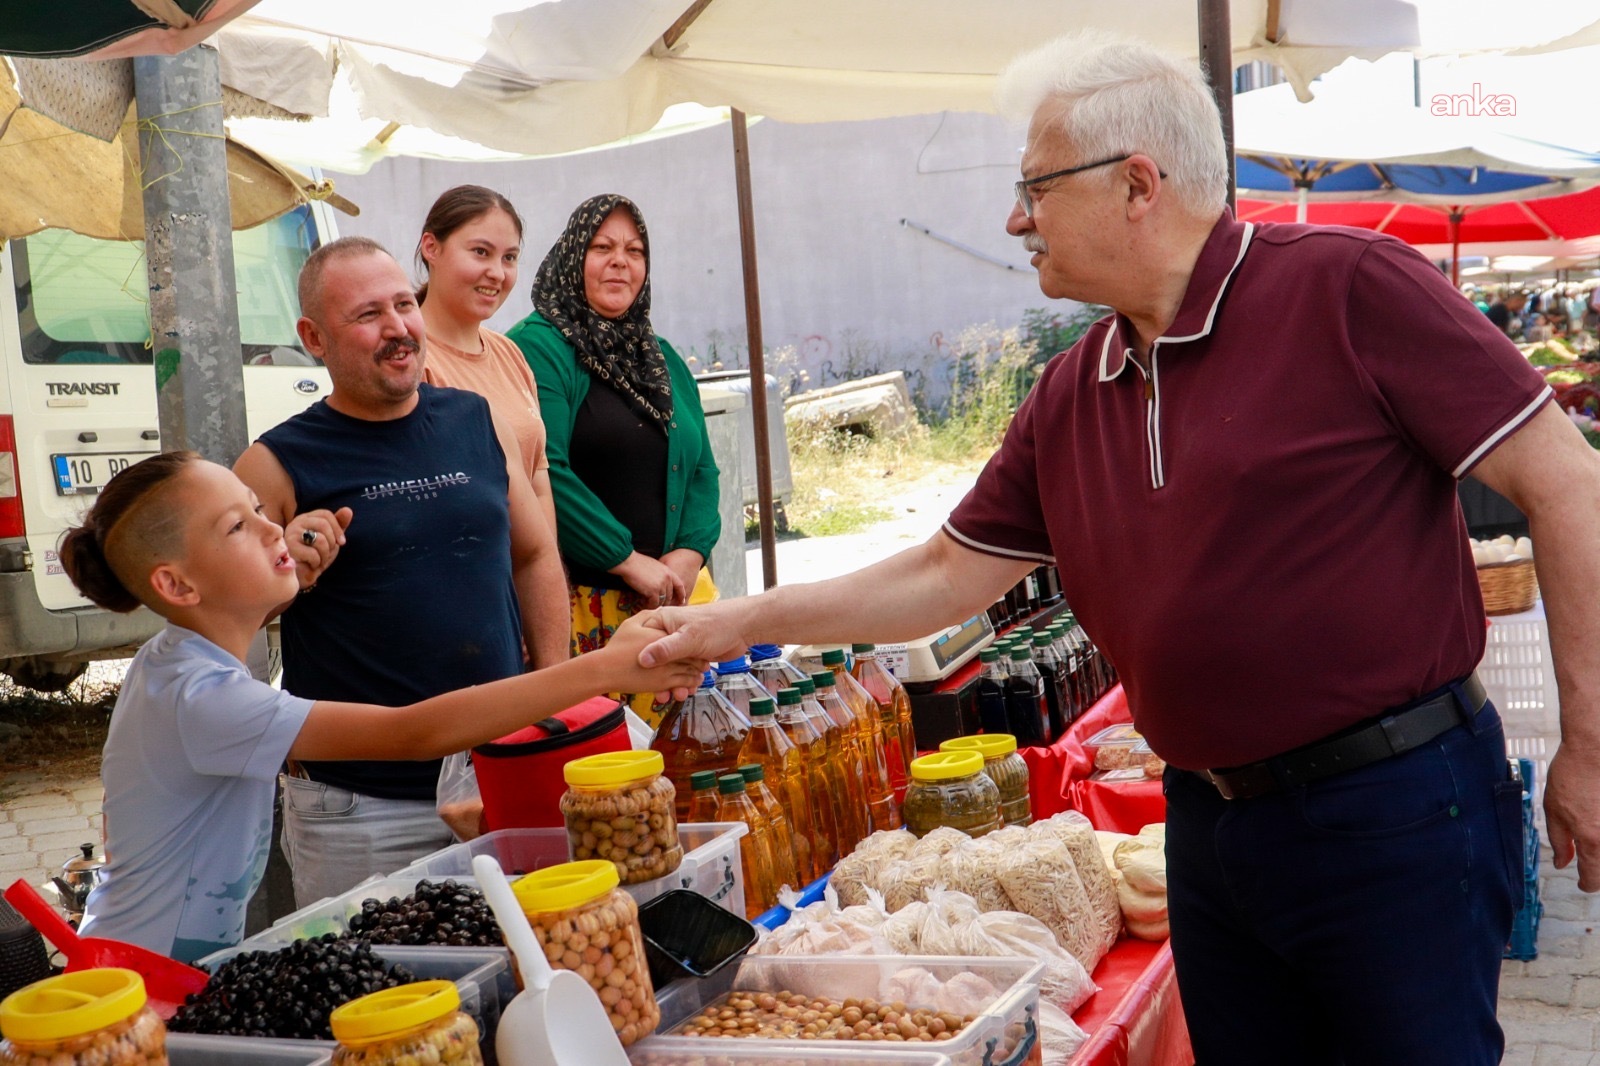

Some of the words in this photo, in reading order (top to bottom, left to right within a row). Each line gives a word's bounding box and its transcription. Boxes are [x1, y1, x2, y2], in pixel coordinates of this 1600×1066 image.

[45, 382, 120, 395] TRANSIT
[71, 460, 92, 484] 10
[362, 472, 471, 500] UNVEILING
[407, 491, 438, 502] 1988
